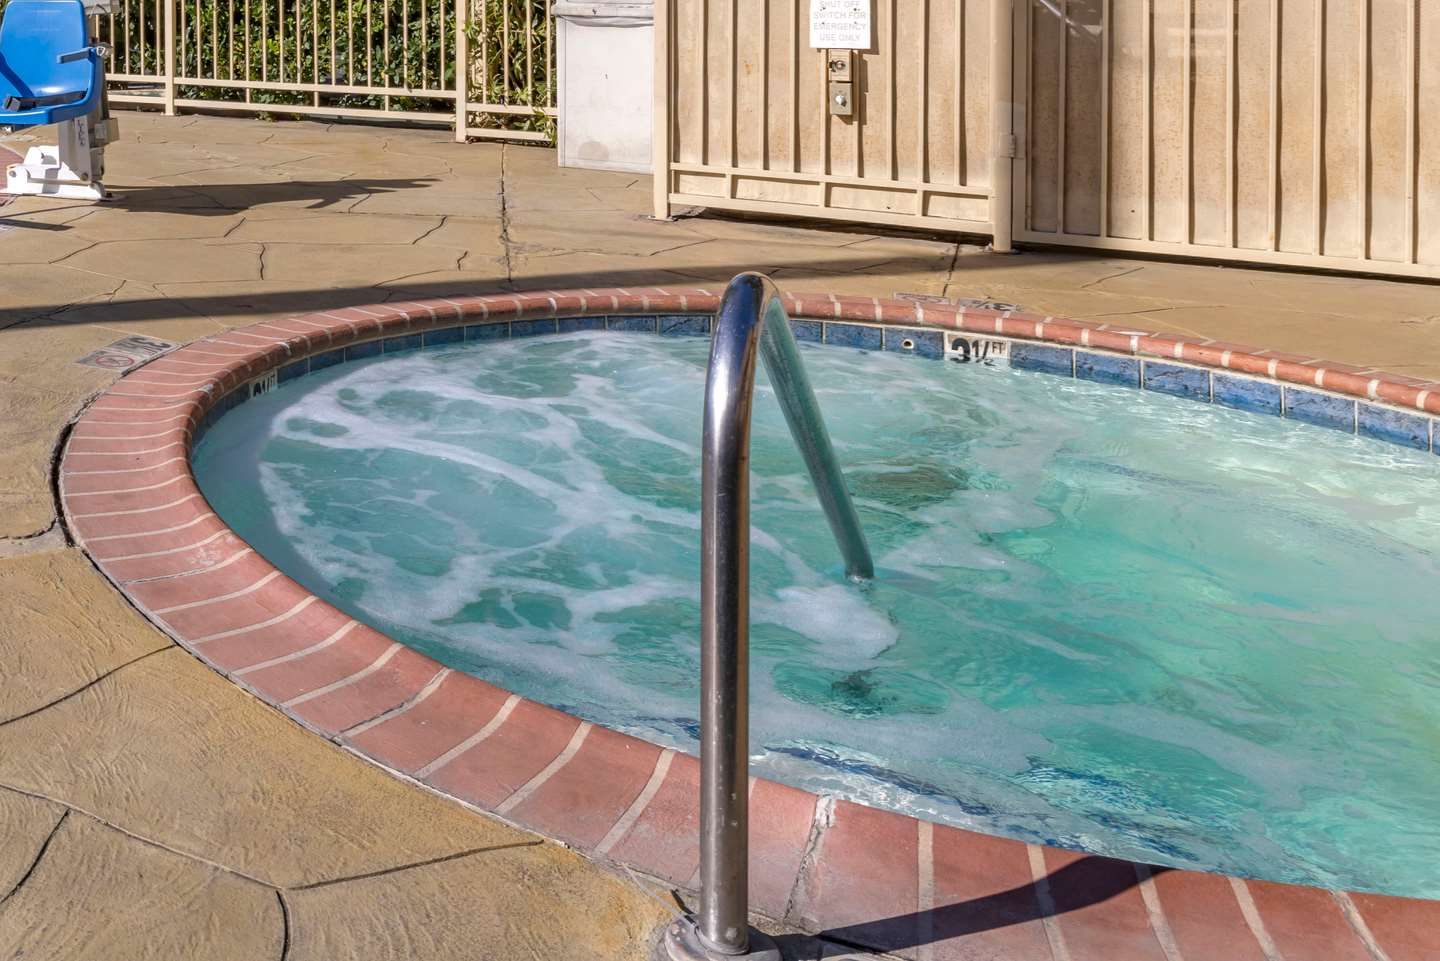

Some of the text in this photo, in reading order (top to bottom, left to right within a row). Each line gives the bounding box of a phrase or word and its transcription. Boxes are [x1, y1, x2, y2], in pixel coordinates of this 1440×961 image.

[819, 0, 861, 8] SHUT OFF
[813, 11, 867, 19] SWITCH FOR
[813, 22, 867, 31] EMERGENCY
[819, 33, 862, 41] USE ONLY
[992, 341, 1004, 354] FT
